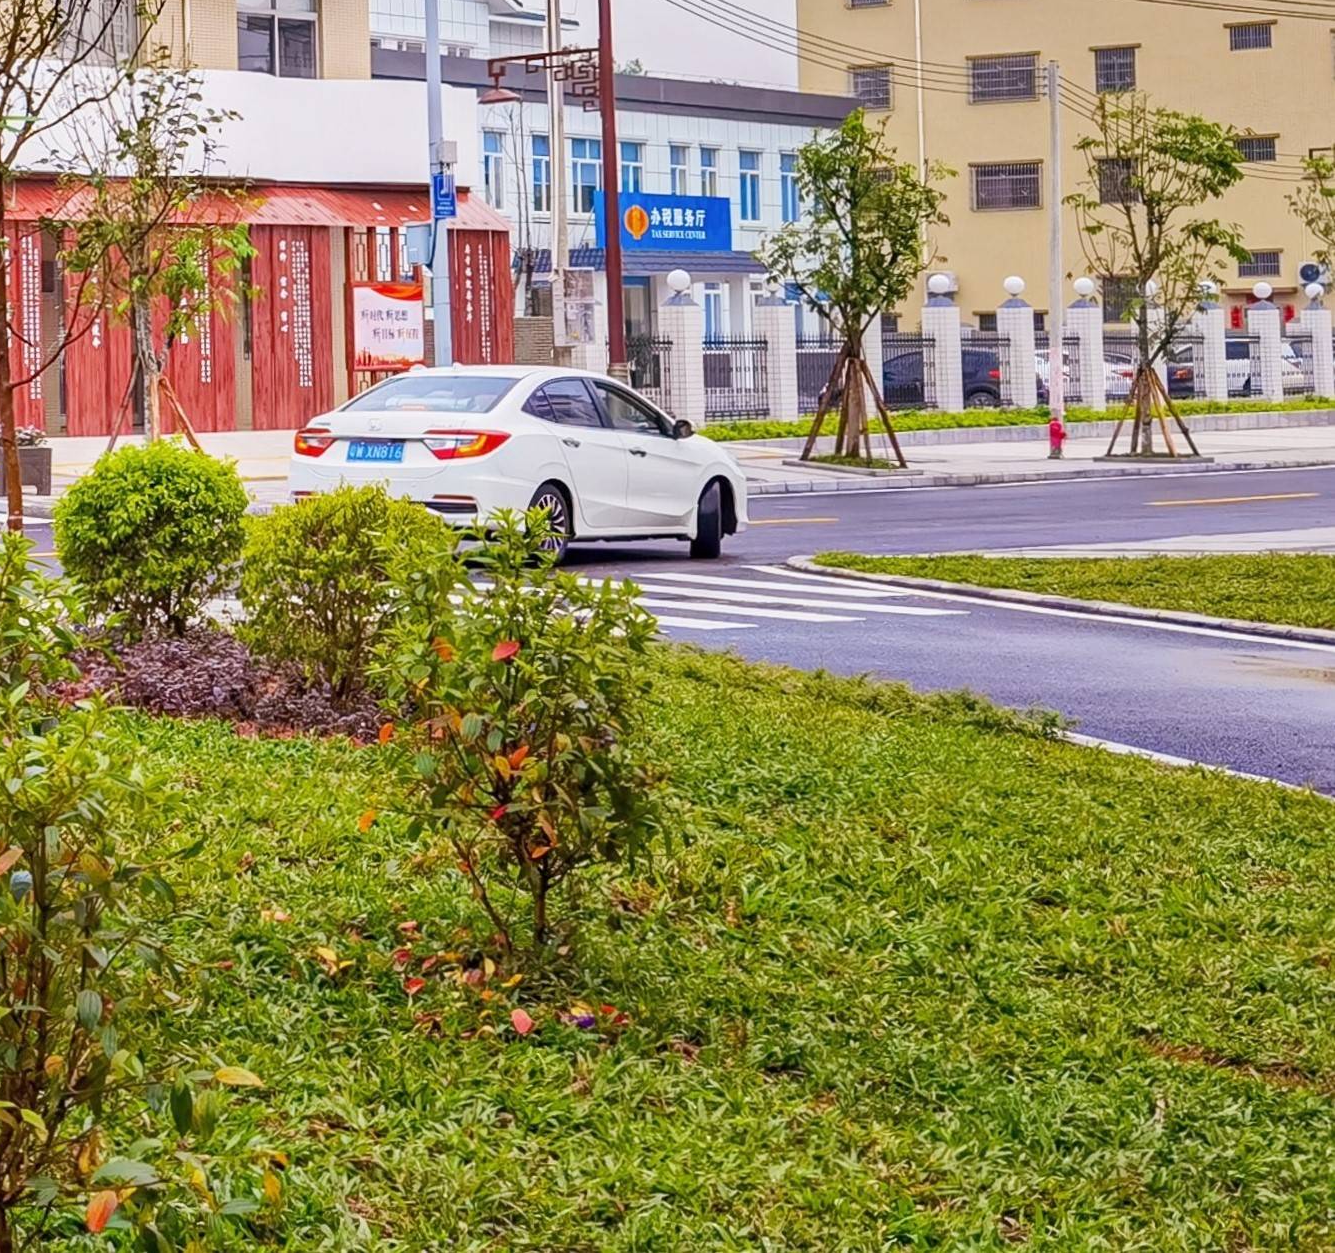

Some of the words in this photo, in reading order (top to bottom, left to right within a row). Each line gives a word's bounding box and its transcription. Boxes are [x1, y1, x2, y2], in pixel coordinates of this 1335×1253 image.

[650, 207, 706, 227] 办税服务厅
[651, 229, 662, 238] TAX
[662, 229, 684, 239] SERVICE
[684, 230, 706, 239] CENTER
